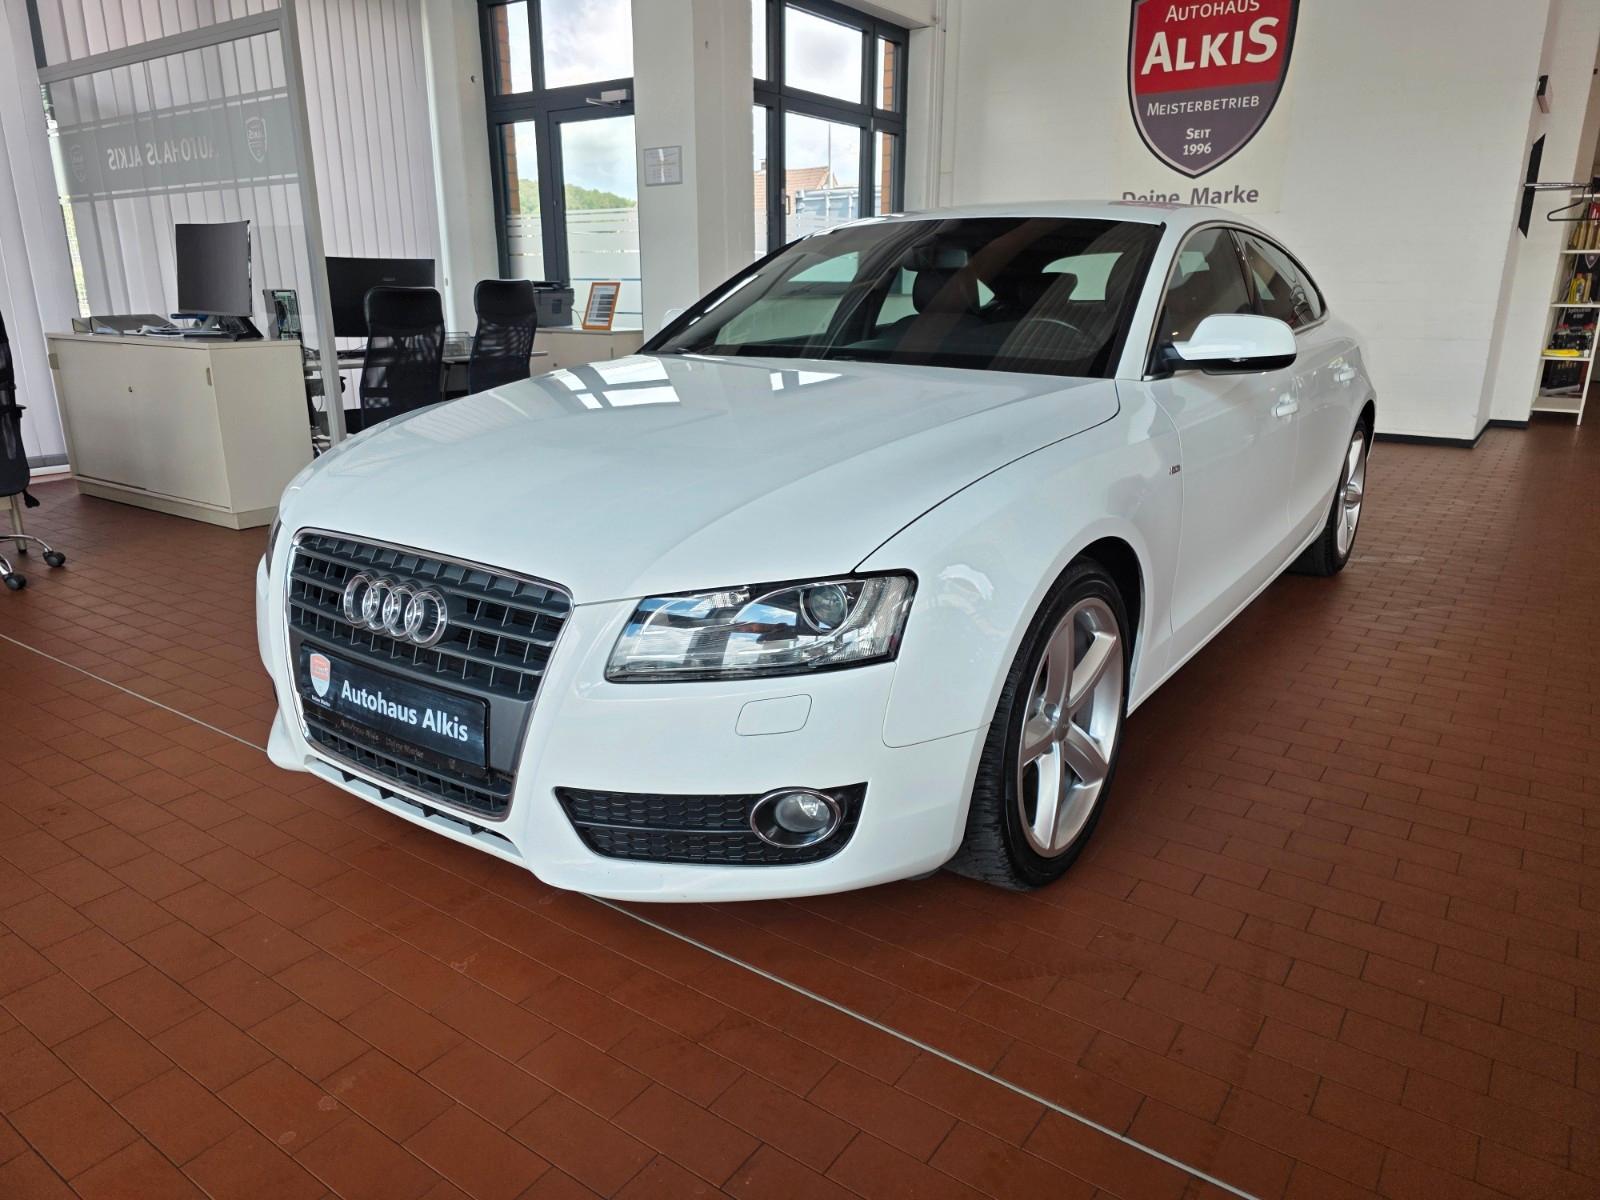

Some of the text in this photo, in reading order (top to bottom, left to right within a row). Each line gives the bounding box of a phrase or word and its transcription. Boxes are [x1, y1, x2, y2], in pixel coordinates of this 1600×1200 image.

[1165, 0, 1260, 23] AUTOHAUS
[1141, 16, 1280, 76] ALKIS
[1147, 95, 1260, 117] MEISTERBETRIEB
[1186, 127, 1211, 140] SEIT
[1183, 143, 1212, 156] 1996
[1190, 185, 1260, 205] Marke
[341, 679, 418, 725] Autohaus
[422, 708, 469, 742] Alkis
